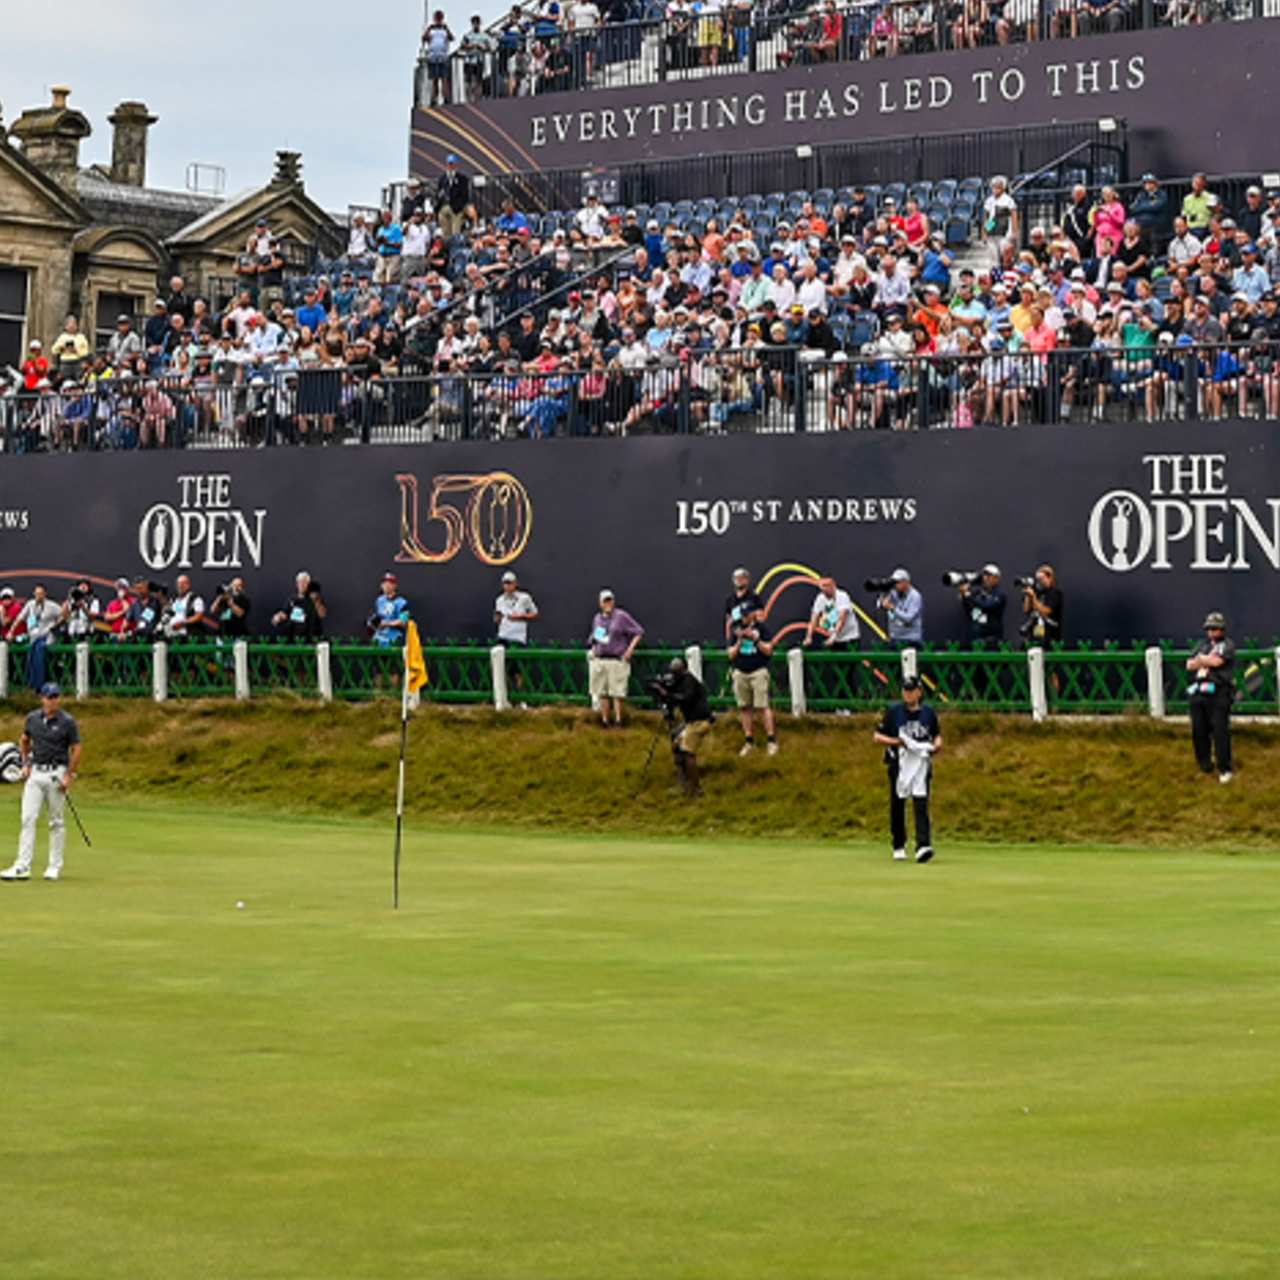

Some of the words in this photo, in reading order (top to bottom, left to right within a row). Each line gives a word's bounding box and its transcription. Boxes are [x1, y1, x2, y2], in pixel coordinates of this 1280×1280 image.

[530, 95, 766, 147] EVERYTHING
[783, 87, 860, 120] HAS
[880, 75, 952, 112] LED
[972, 68, 1026, 103] TO
[1046, 56, 1147, 96] THIS
[178, 475, 232, 508] THE
[1142, 454, 1227, 496] THE
[139, 503, 267, 570] OPEN
[395, 470, 532, 565] 150
[752, 500, 781, 522] ST
[788, 497, 918, 522] ANDREWS
